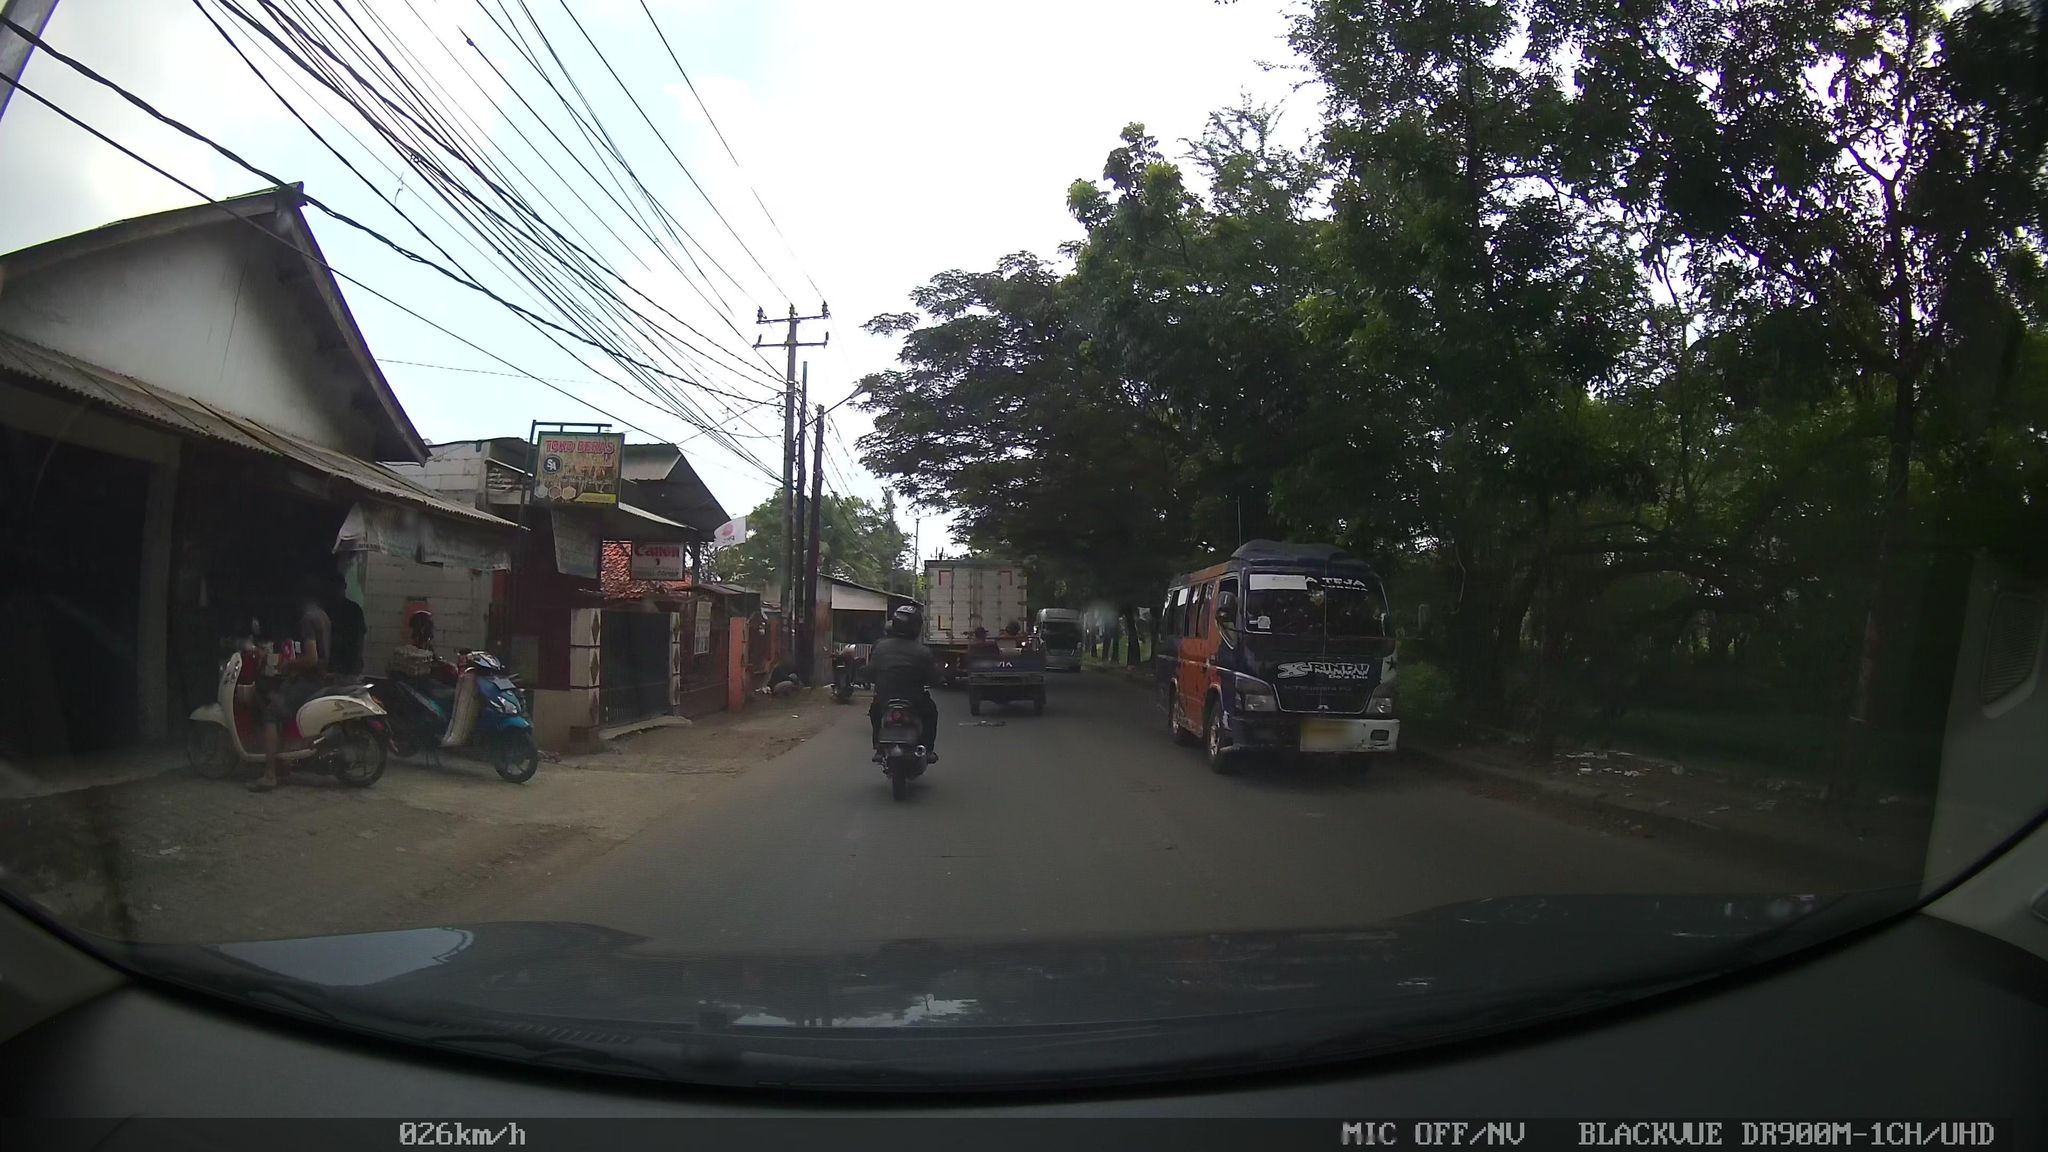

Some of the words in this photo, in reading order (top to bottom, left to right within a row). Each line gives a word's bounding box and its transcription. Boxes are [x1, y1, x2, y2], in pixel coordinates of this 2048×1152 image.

[545, 440, 576, 453] TOKO
[577, 440, 616, 455] BERAS
[635, 545, 680, 557] Canon
[1321, 577, 1366, 587] TEJA
